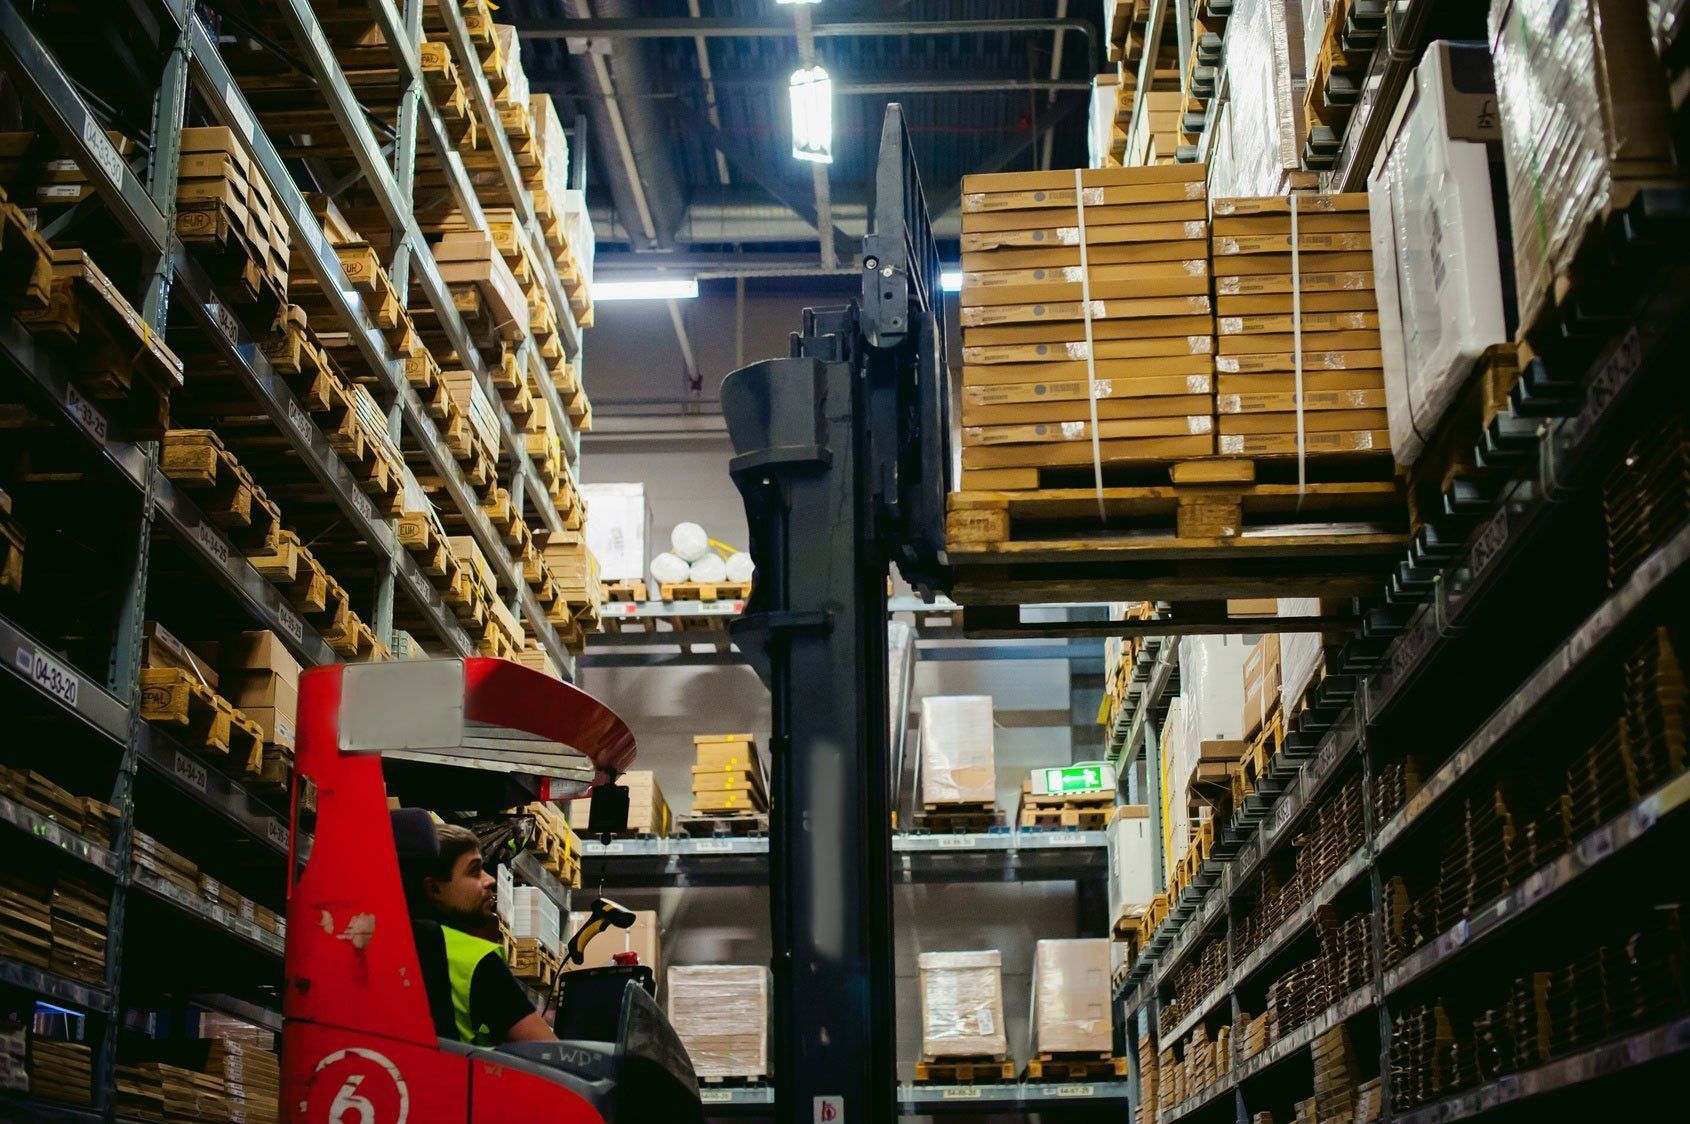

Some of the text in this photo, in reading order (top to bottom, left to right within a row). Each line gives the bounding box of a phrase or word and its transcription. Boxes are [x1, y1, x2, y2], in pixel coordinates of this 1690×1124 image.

[86, 121, 121, 183] 04-33-30
[200, 526, 227, 563] 04-34-25
[36, 658, 76, 703] 04-33-20
[269, 822, 289, 845] 04-35-2
[329, 1074, 375, 1124] 6
